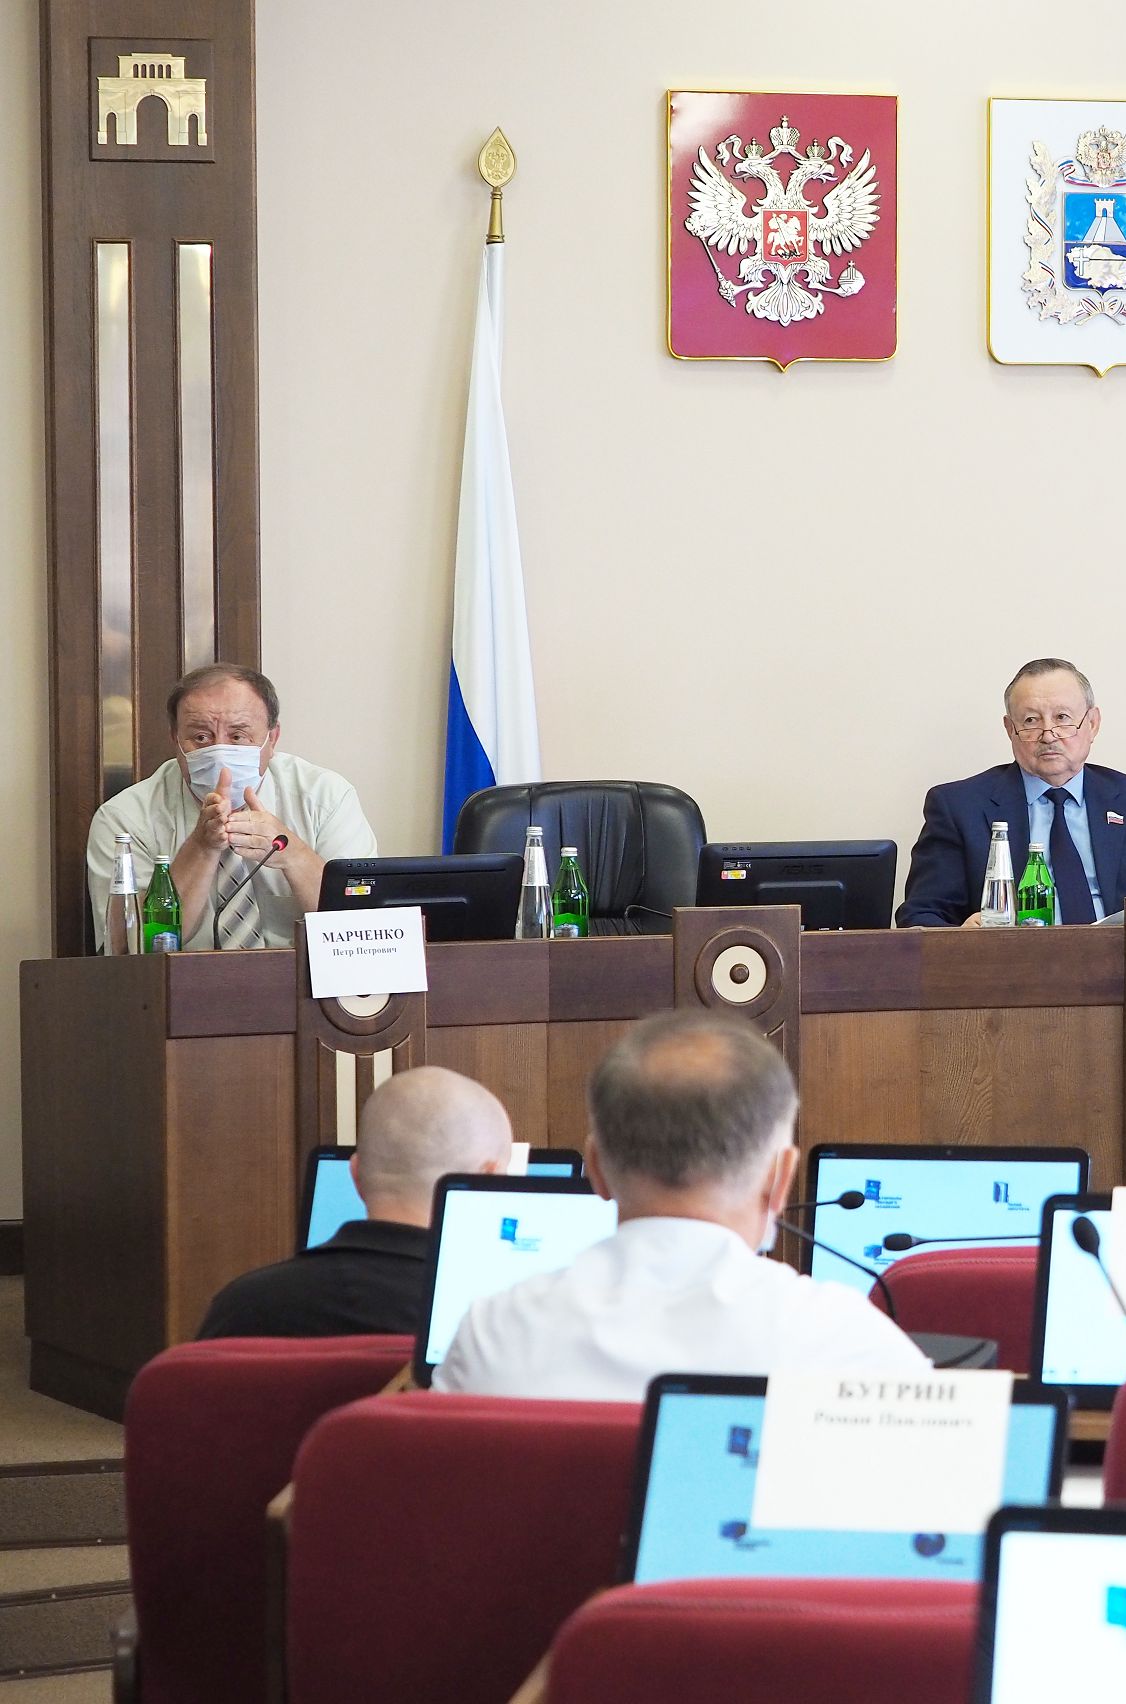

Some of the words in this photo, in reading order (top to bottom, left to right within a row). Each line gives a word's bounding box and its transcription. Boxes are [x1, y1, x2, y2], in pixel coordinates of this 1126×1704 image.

[322, 928, 405, 943] МАРЧЕНКО
[332, 948, 354, 957] Петр
[356, 946, 397, 956] Петрович
[838, 1381, 956, 1400] БУГРИН
